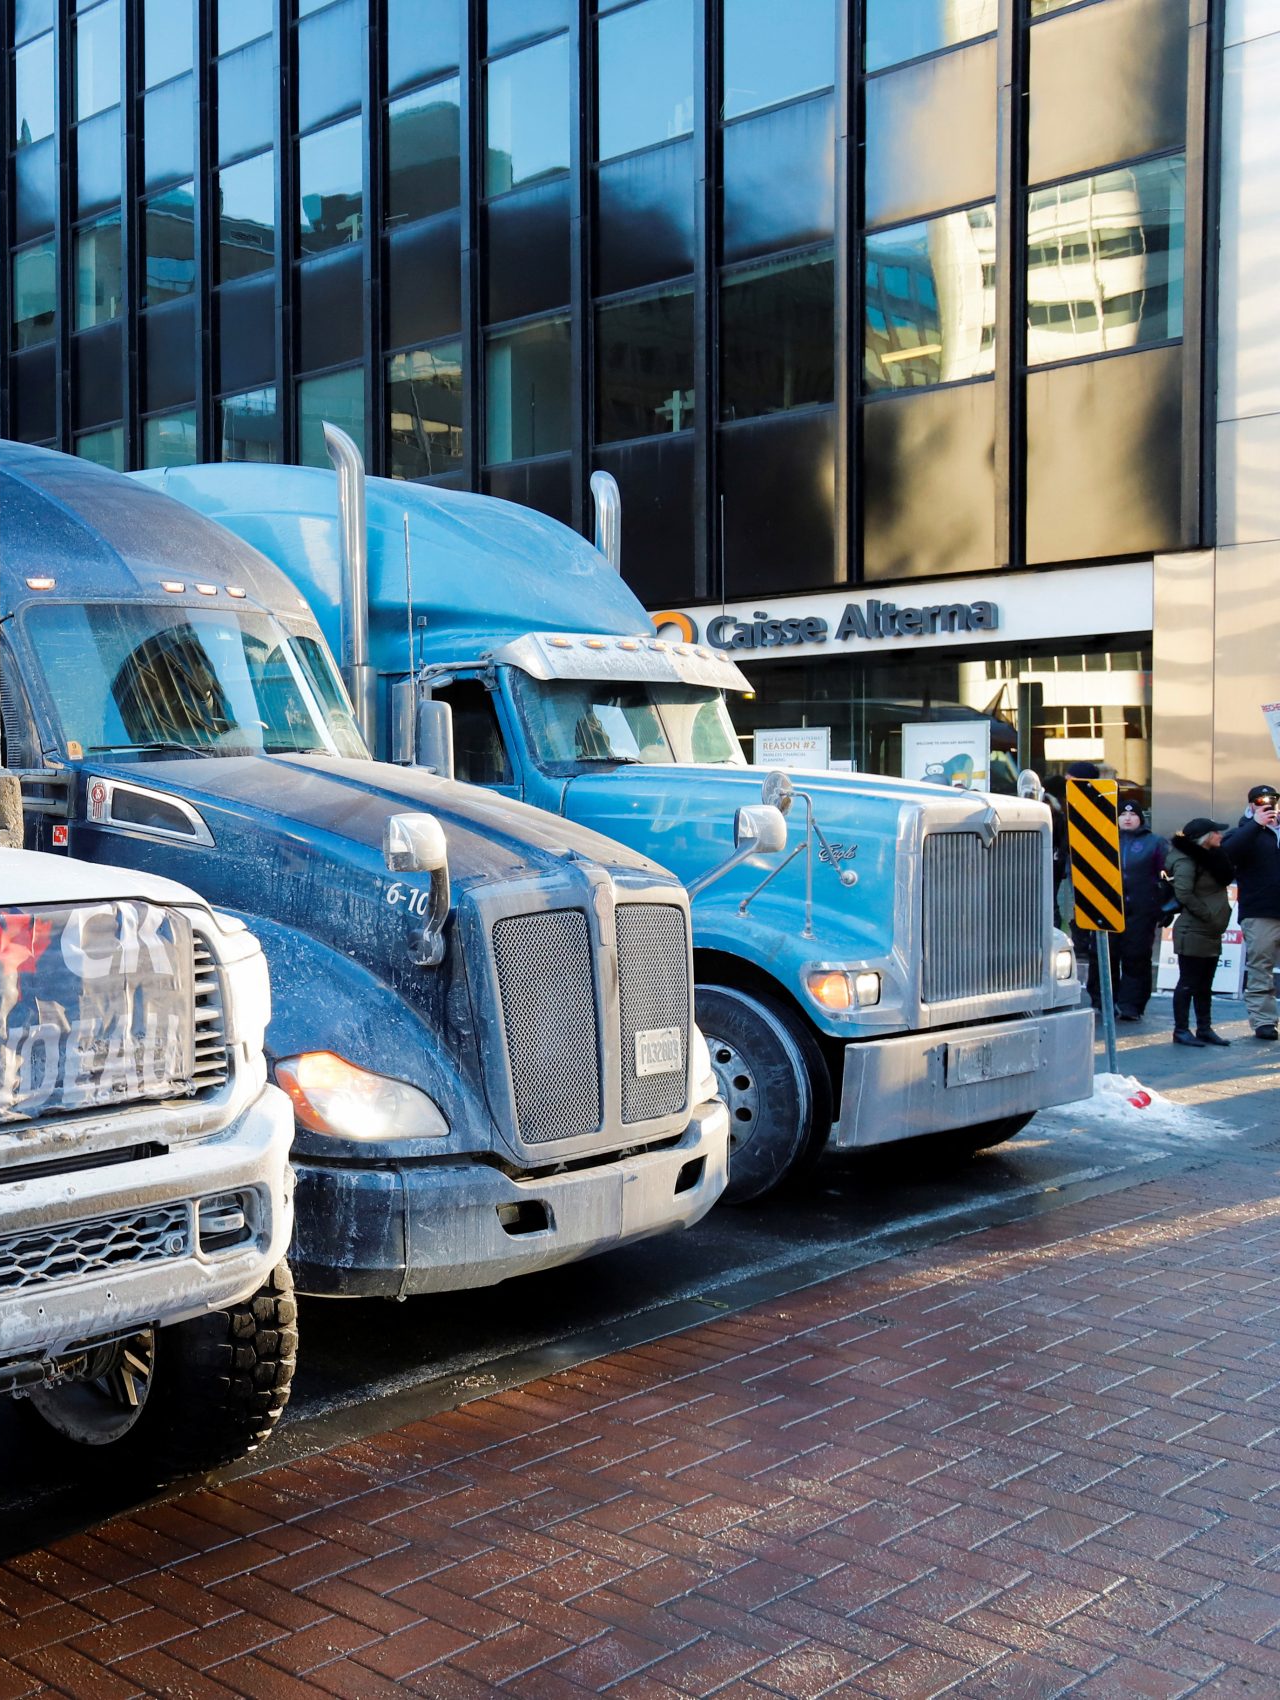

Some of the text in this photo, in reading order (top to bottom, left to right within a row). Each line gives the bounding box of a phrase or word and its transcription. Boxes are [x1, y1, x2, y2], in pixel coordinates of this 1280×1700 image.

[706, 599, 999, 650] Caisse Alterna
[763, 741, 817, 751] REASON #2
